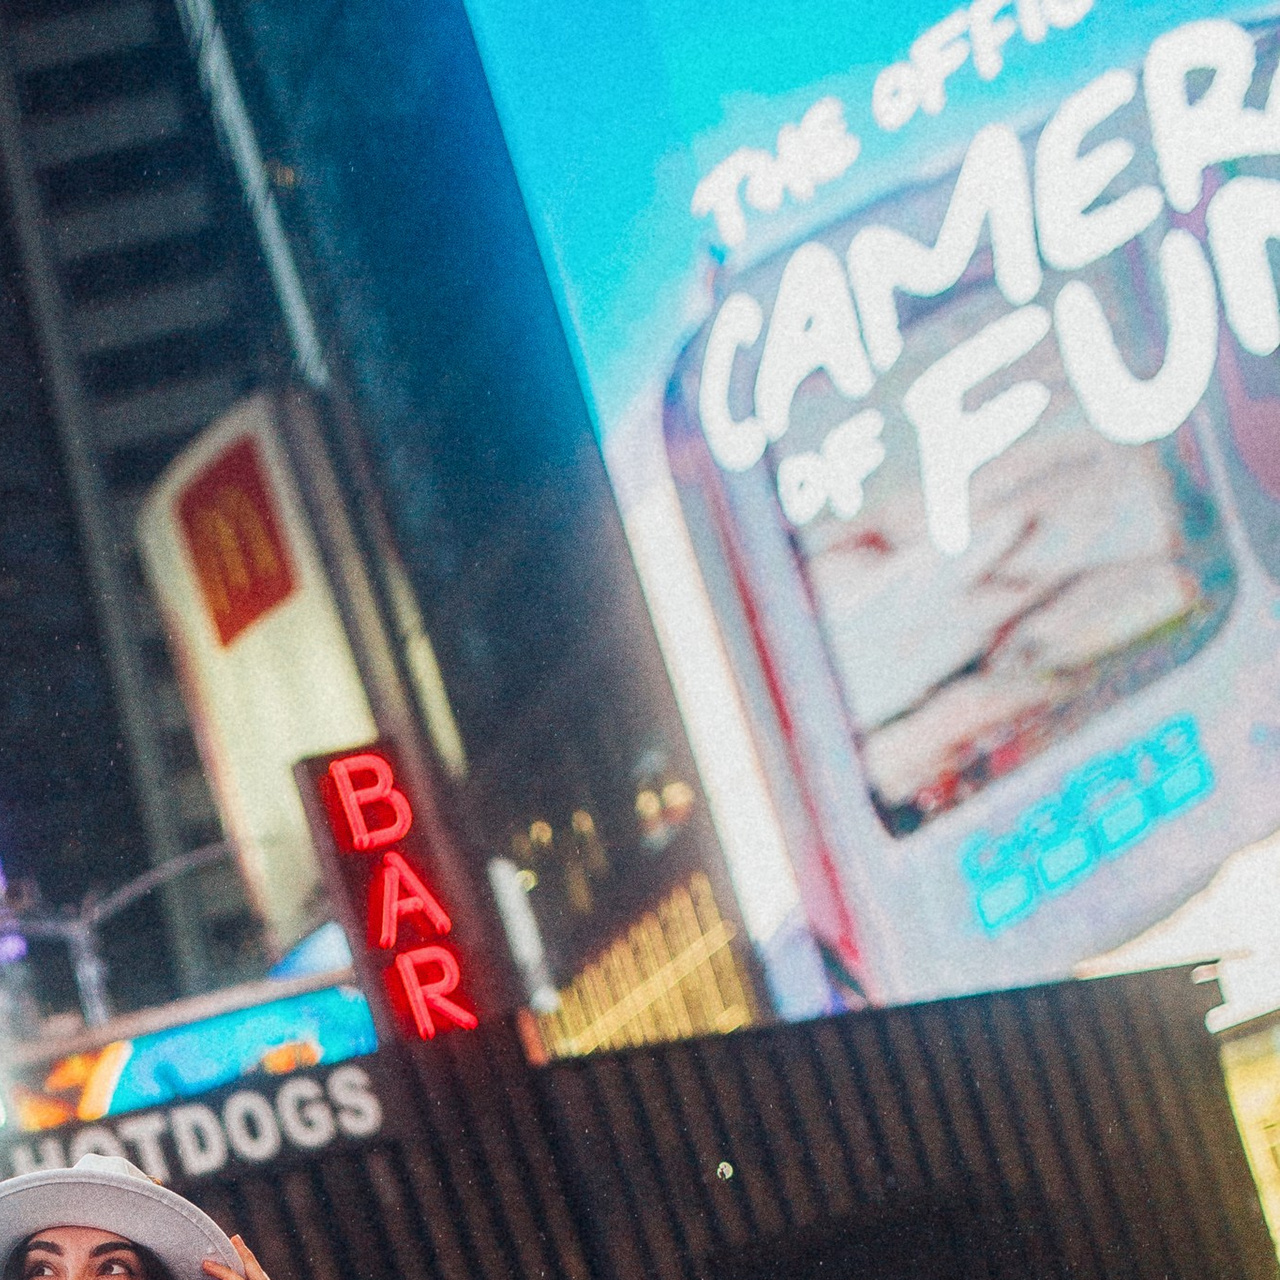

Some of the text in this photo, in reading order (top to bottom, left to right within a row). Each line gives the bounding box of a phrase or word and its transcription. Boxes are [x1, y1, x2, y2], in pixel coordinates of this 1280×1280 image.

[690, 96, 861, 246] THE
[776, 408, 886, 527] OF
[328, 752, 480, 1041] BAR
